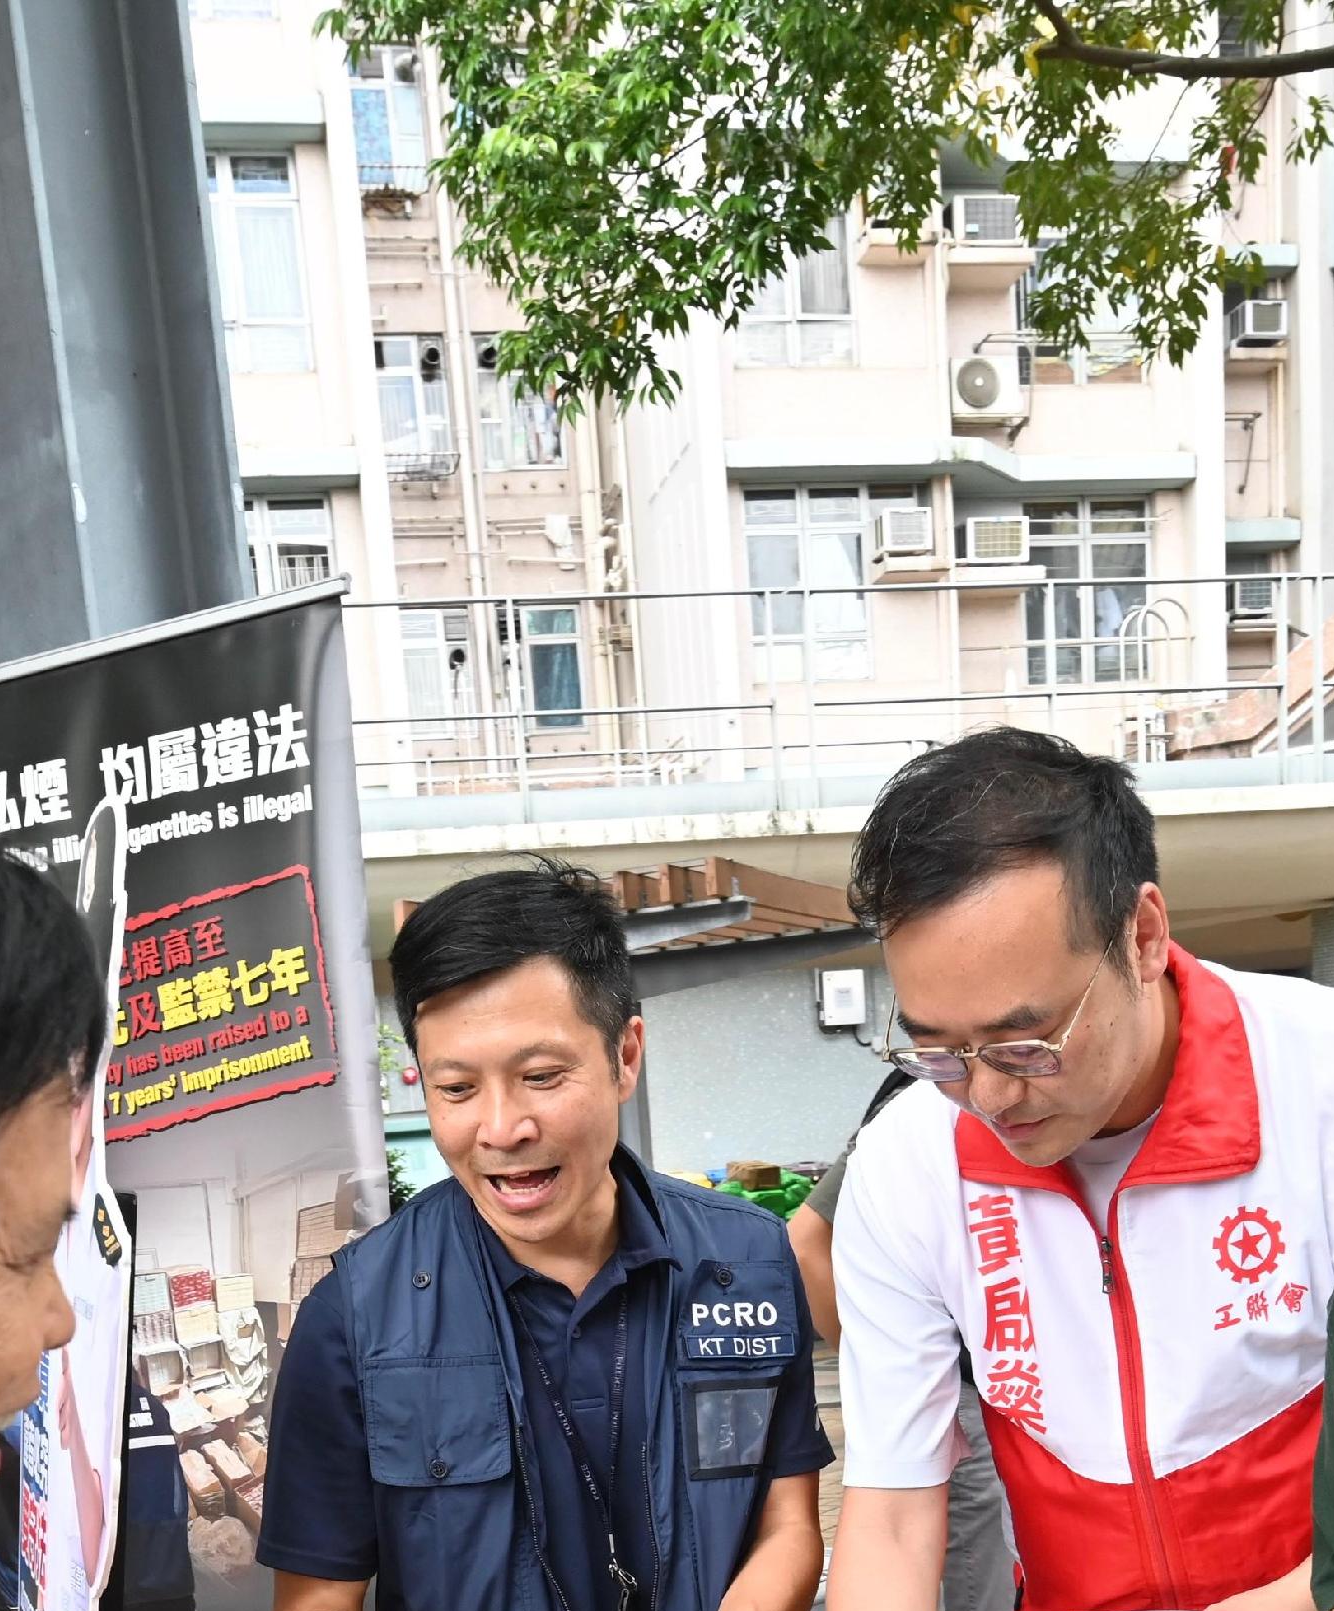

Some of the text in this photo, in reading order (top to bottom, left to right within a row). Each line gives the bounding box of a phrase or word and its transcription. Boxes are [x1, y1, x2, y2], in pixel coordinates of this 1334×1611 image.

[99, 703, 310, 805] 均屬違法
[217, 802, 239, 829] is
[243, 784, 313, 823] illegal
[126, 1051, 160, 1078] has
[160, 1034, 205, 1061] been
[208, 1012, 267, 1049] raised
[269, 1008, 291, 1033] to
[294, 1005, 310, 1026] a
[109, 1091, 122, 1115] 7
[182, 1034, 314, 1095] imprisonment
[691, 1301, 778, 1327] PCRO
[1214, 1281, 1309, 1331] 工聯會
[699, 1336, 782, 1355] KT DIST
